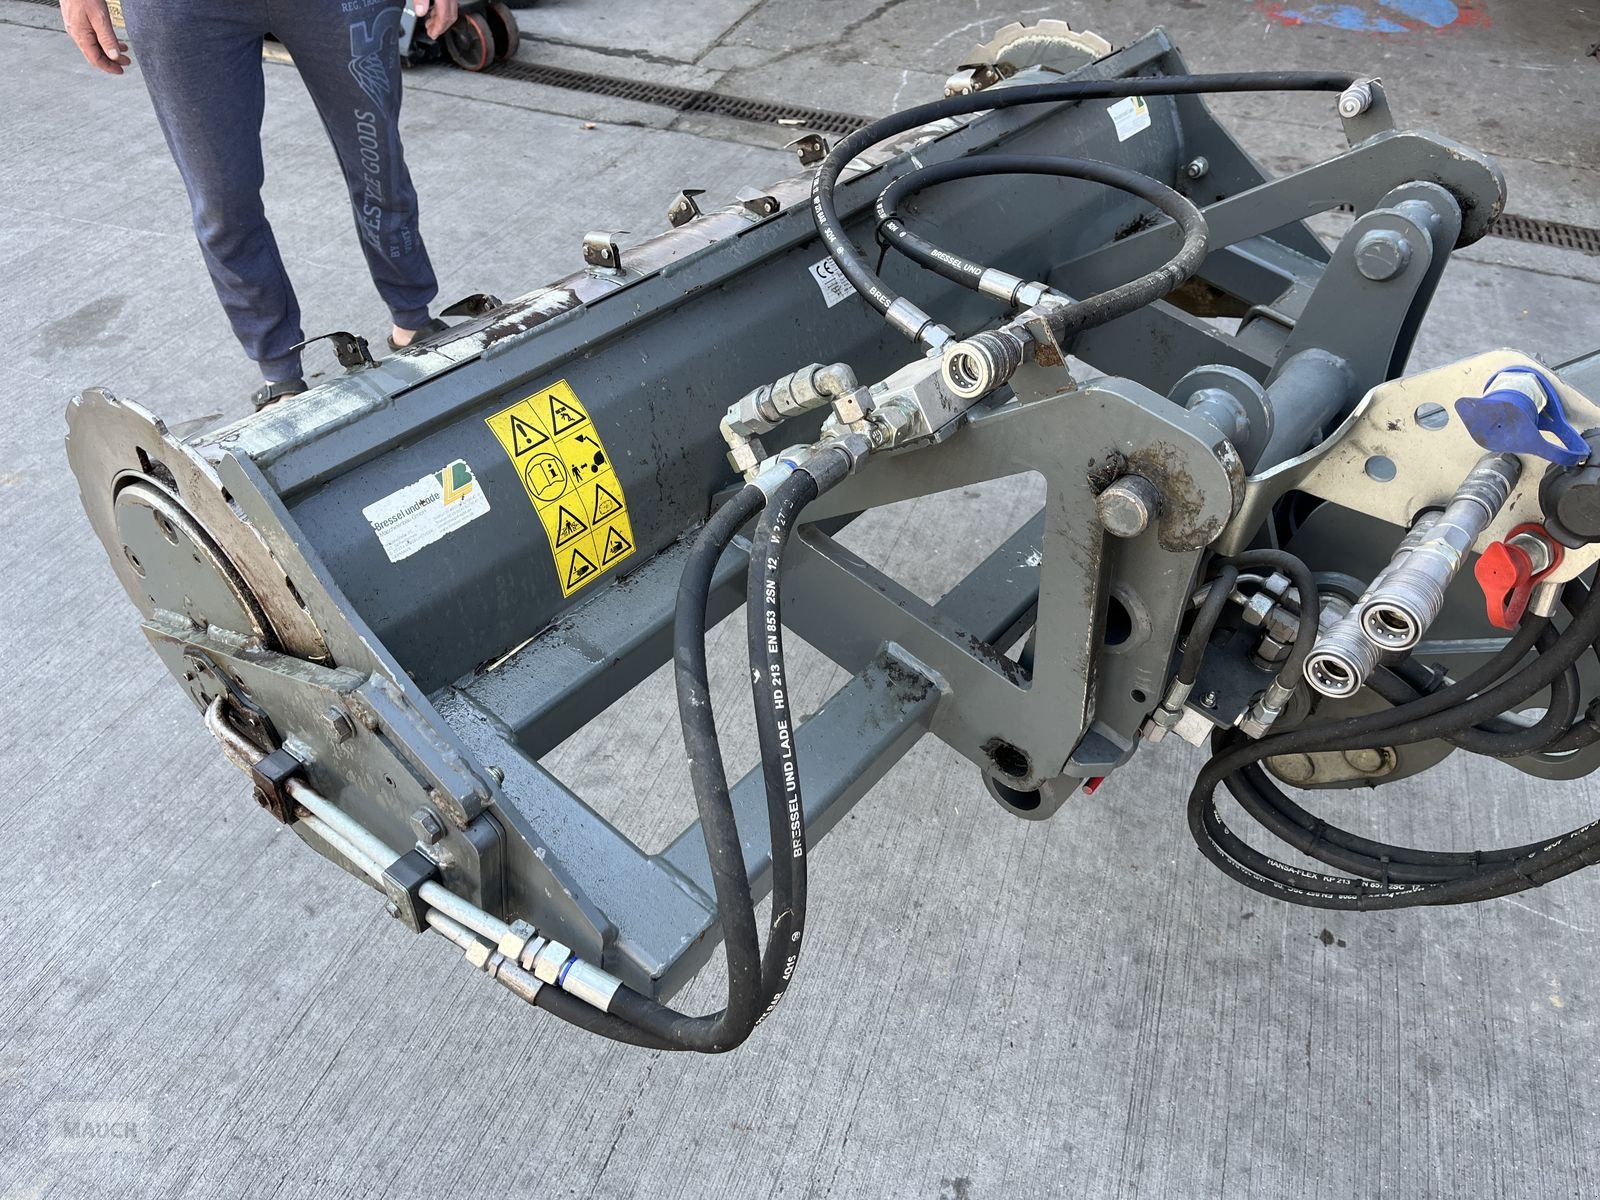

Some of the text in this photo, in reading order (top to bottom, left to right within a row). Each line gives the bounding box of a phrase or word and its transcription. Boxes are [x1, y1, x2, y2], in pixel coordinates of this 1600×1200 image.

[354, 109, 380, 174] GOODS
[931, 249, 982, 276] BRESSEL UND
[869, 286, 892, 307] BRES
[374, 510, 405, 532] Bressel
[405, 501, 421, 517] und
[766, 579, 776, 604] 2SN
[766, 610, 777, 632] 853
[768, 635, 778, 653] EN
[770, 664, 782, 686] 213
[774, 689, 785, 709] HD
[777, 719, 792, 759] LADE
[784, 761, 796, 792] UND
[789, 793, 803, 858] BRESSEL
[1266, 858, 1318, 880] HANSA-FLEX
[782, 955, 797, 980] 4Q15
